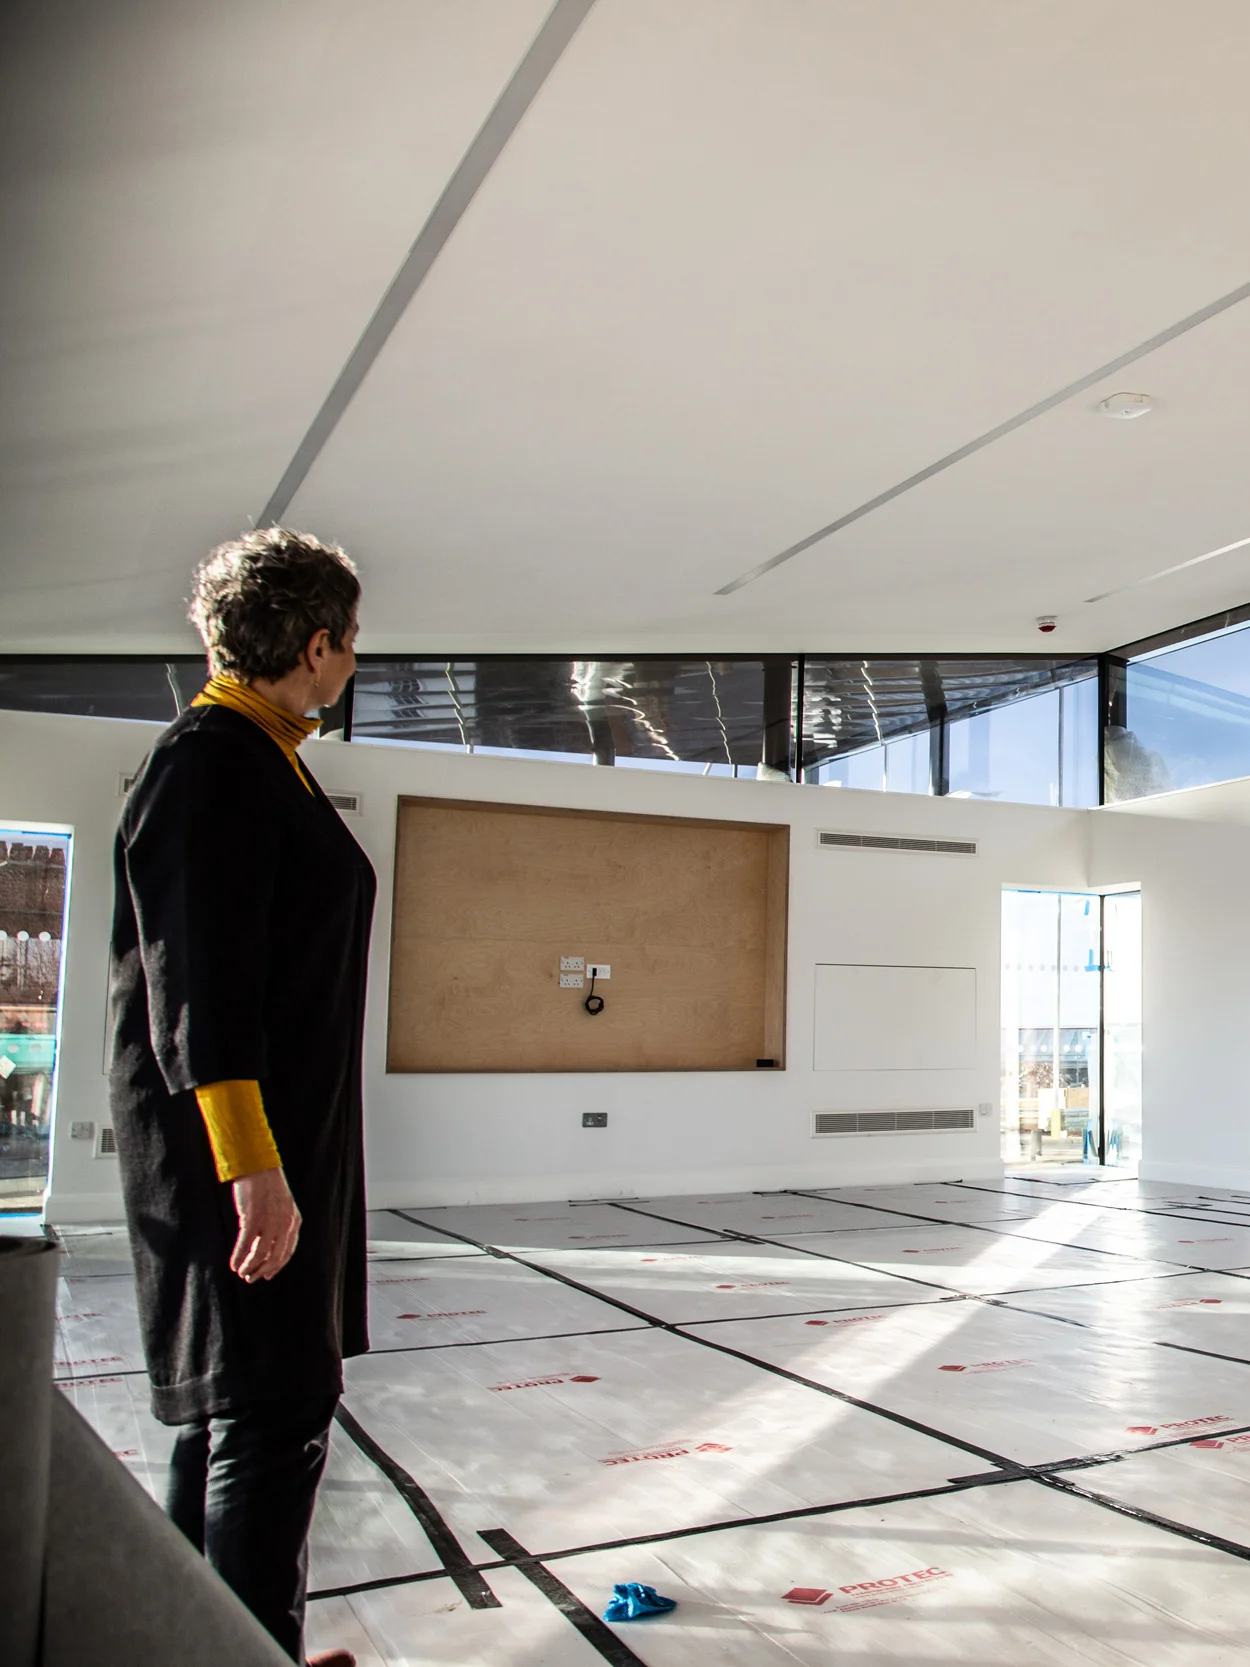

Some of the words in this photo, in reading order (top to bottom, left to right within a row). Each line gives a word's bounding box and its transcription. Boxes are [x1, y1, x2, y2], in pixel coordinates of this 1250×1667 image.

[1159, 1415, 1229, 1429] PROTEC
[601, 1449, 690, 1466] PROTEC
[838, 1566, 948, 1594] PROTEC
